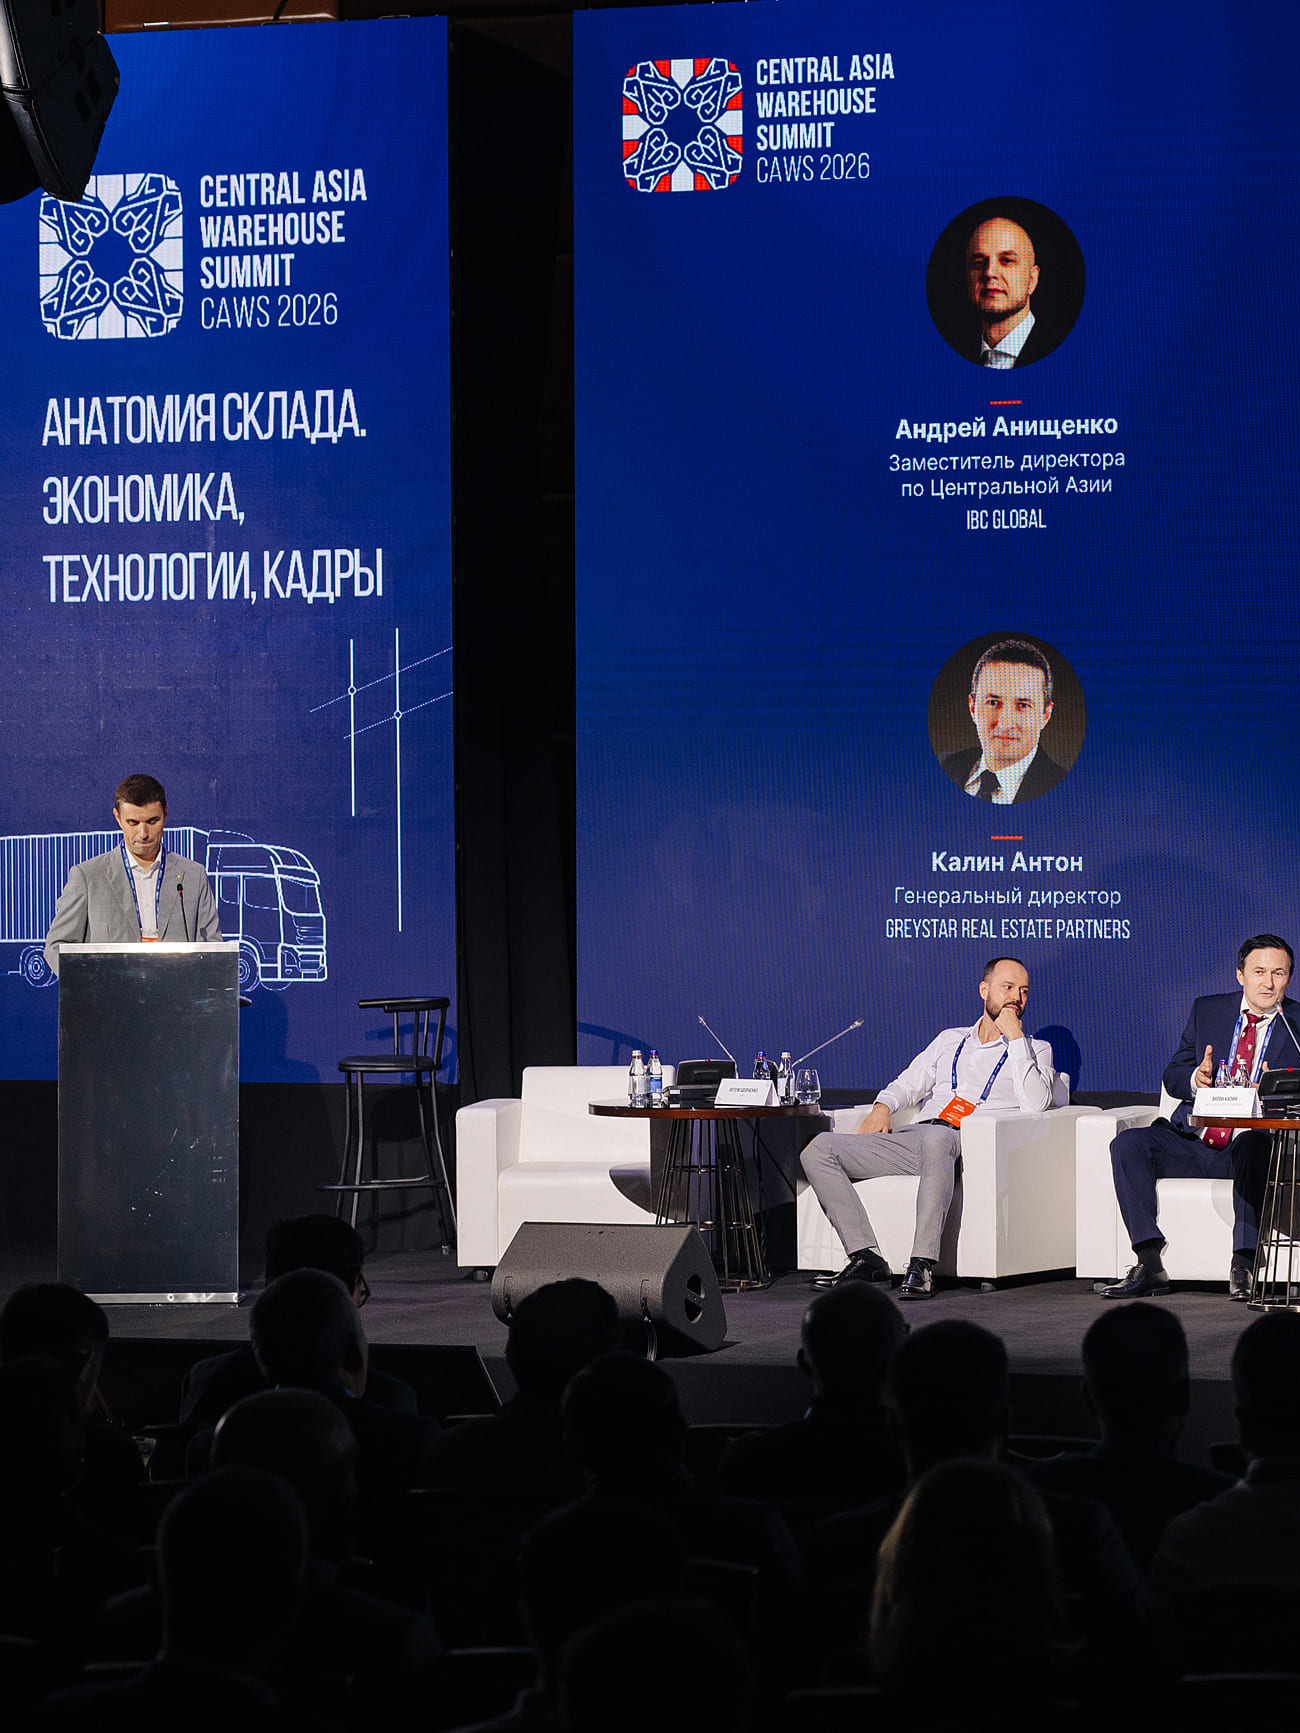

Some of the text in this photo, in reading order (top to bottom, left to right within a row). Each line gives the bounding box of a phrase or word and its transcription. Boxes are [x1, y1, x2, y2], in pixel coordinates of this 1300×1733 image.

[757, 53, 894, 85] CENTRAL ASIA
[756, 89, 876, 118] WAREHOUSE
[756, 122, 835, 151] SUMMIT
[757, 153, 869, 183] CAWS 2026
[200, 168, 367, 208] CENTRAL ASIA
[200, 210, 345, 248] WAREHOUSE
[200, 253, 295, 289] SUMMIT
[201, 292, 337, 329] CAWS 2026
[42, 389, 366, 446] АНАТОМИЯ СКЛАДА.
[896, 416, 1117, 443] Андрей Анищенко
[890, 453, 1124, 471] Заместитель директора
[43, 472, 244, 526] ЭКОНОМИКА,
[902, 476, 1111, 499] по Центральной Азии
[967, 509, 1046, 529] IBC GLOBAL
[42, 548, 382, 605] ТЕХНОЛОГИИ, КАДРЫ
[932, 852, 1082, 871] Калин Антон
[895, 887, 1121, 908] Генеральный директор
[886, 919, 1130, 939] GREYSTAR REAL ESTATE PARTNERS
